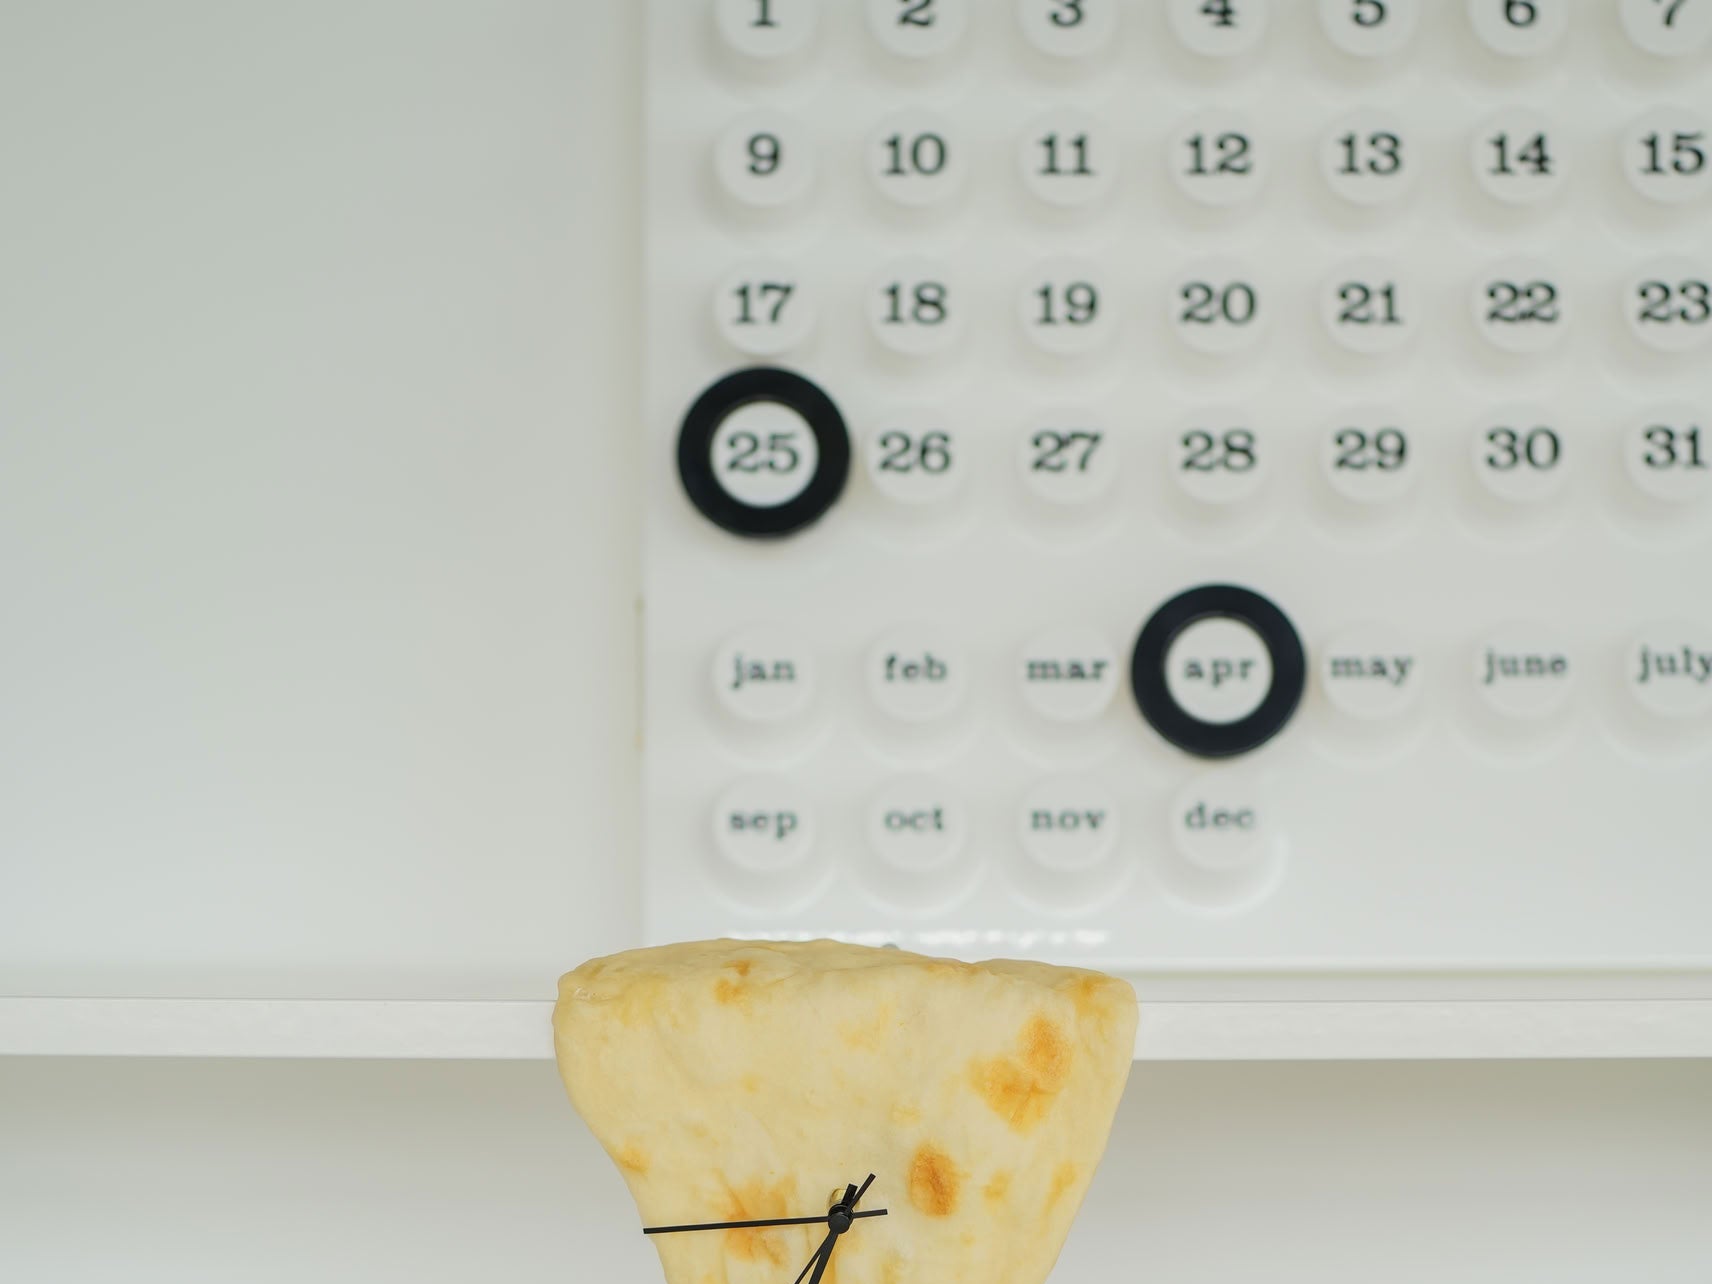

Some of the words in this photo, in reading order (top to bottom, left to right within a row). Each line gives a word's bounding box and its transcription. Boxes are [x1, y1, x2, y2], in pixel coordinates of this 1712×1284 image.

[752, 0, 779, 28] 1
[898, 0, 934, 29] 2
[1049, 0, 1085, 28] 3
[1201, 0, 1237, 28] 4
[1352, 0, 1387, 28] 5
[1503, 0, 1538, 27] 6
[747, 133, 781, 176] 9
[883, 133, 948, 177] 10
[1037, 134, 1096, 177] 11
[1185, 132, 1252, 177] 12
[1338, 132, 1403, 176] 13
[1490, 133, 1553, 176] 14
[1639, 132, 1706, 175] 15
[733, 282, 796, 326] 17
[884, 283, 948, 325] 18
[1035, 284, 1099, 326] 19
[1181, 282, 1257, 325] 20
[1337, 282, 1403, 326] 21
[1487, 282, 1558, 324] 22
[1638, 281, 1712, 323] 23
[727, 430, 800, 474] 25
[879, 432, 952, 474] 26
[1031, 431, 1102, 473] 27
[1182, 432, 1256, 472] 28
[1335, 430, 1407, 470] 29
[1486, 428, 1561, 469] 30
[1643, 426, 1709, 469] 31
[731, 653, 797, 691] jan
[884, 653, 948, 682] feb
[1026, 658, 1109, 683] mar
[1184, 658, 1256, 687] apr
[1330, 655, 1413, 685] may
[1484, 648, 1569, 685] june
[1638, 646, 1712, 683] july
[729, 811, 798, 841] sep
[884, 806, 945, 833] oct
[1030, 809, 1106, 832] nov
[1184, 801, 1256, 830] dec
